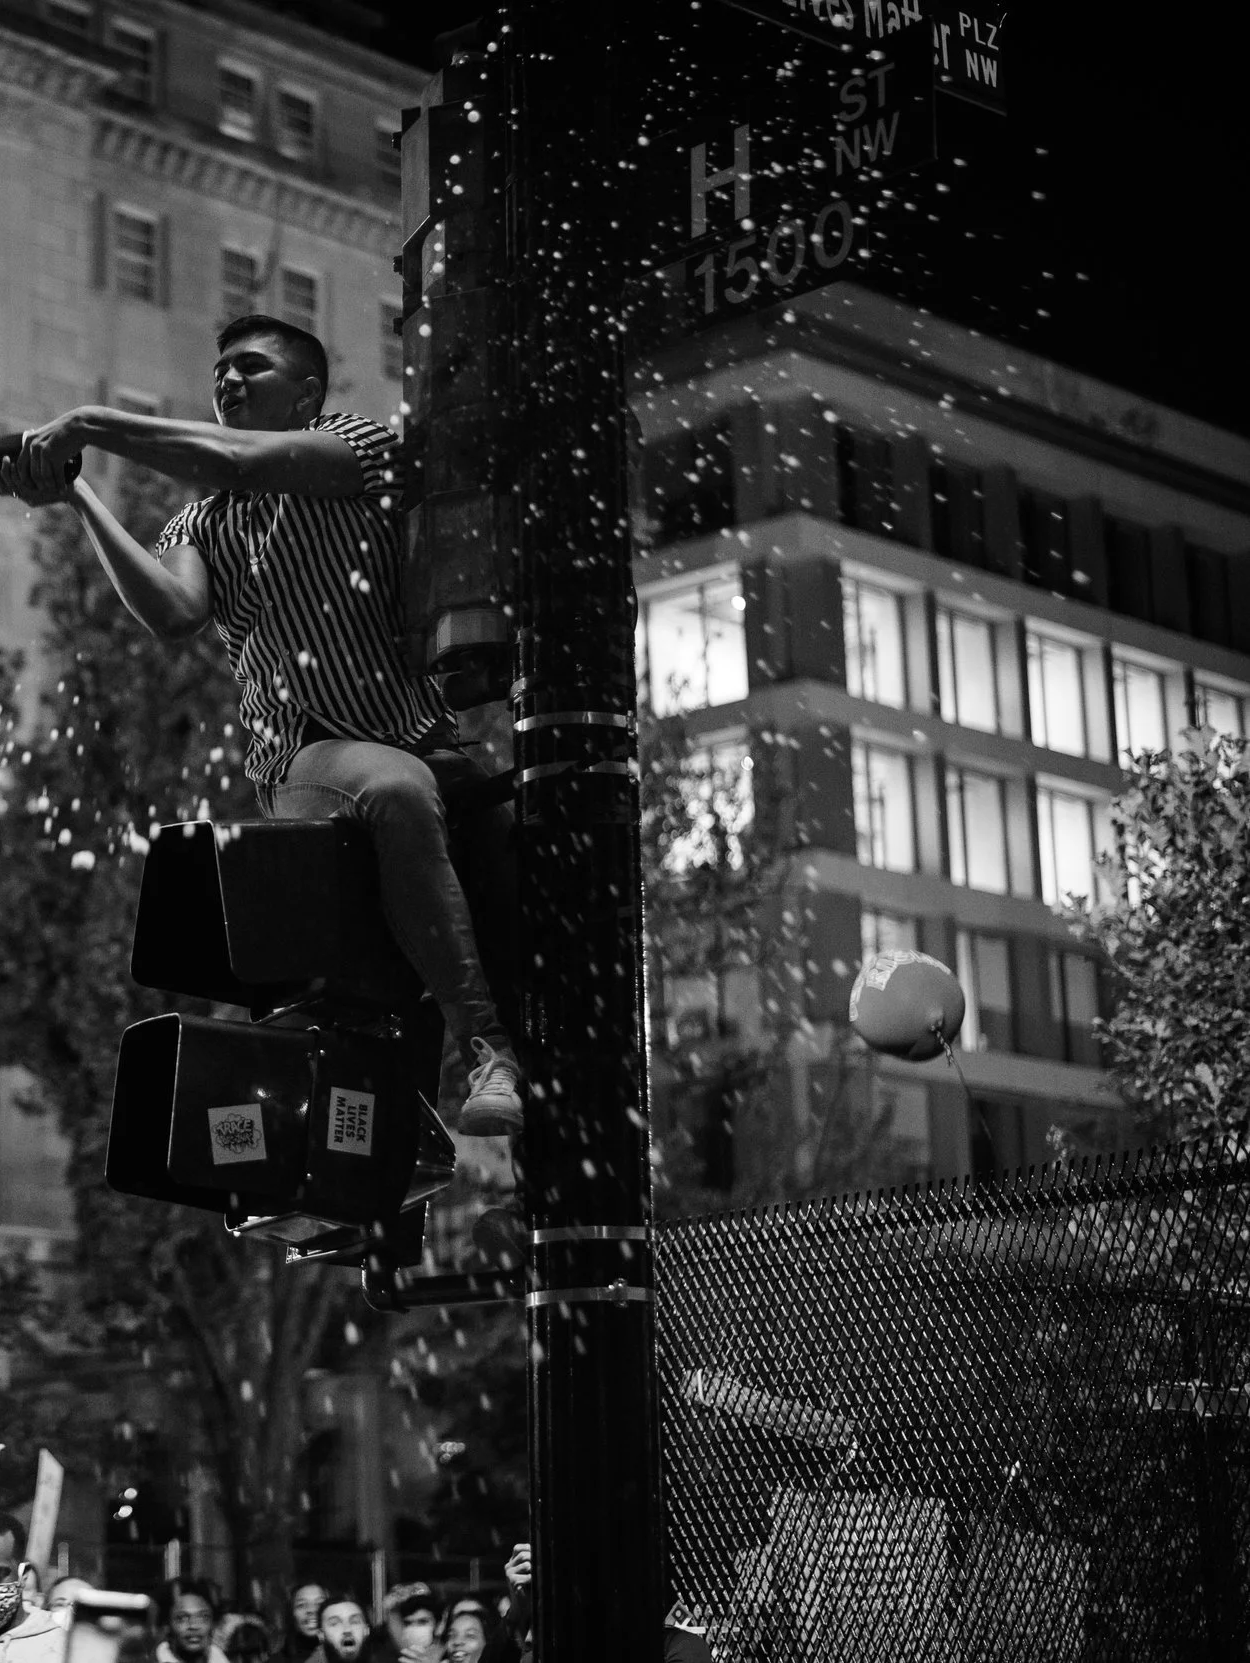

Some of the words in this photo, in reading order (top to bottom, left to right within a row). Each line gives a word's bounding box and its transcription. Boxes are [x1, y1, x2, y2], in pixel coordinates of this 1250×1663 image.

[958, 11, 999, 51] PLZ
[838, 62, 895, 122] ST
[965, 48, 998, 88] NW
[834, 110, 900, 177] NW
[690, 123, 750, 240] H
[693, 200, 854, 315] 1500
[334, 1095, 345, 1143] MATTER
[345, 1105, 356, 1138] LIVES
[355, 1103, 368, 1143] BLACK
